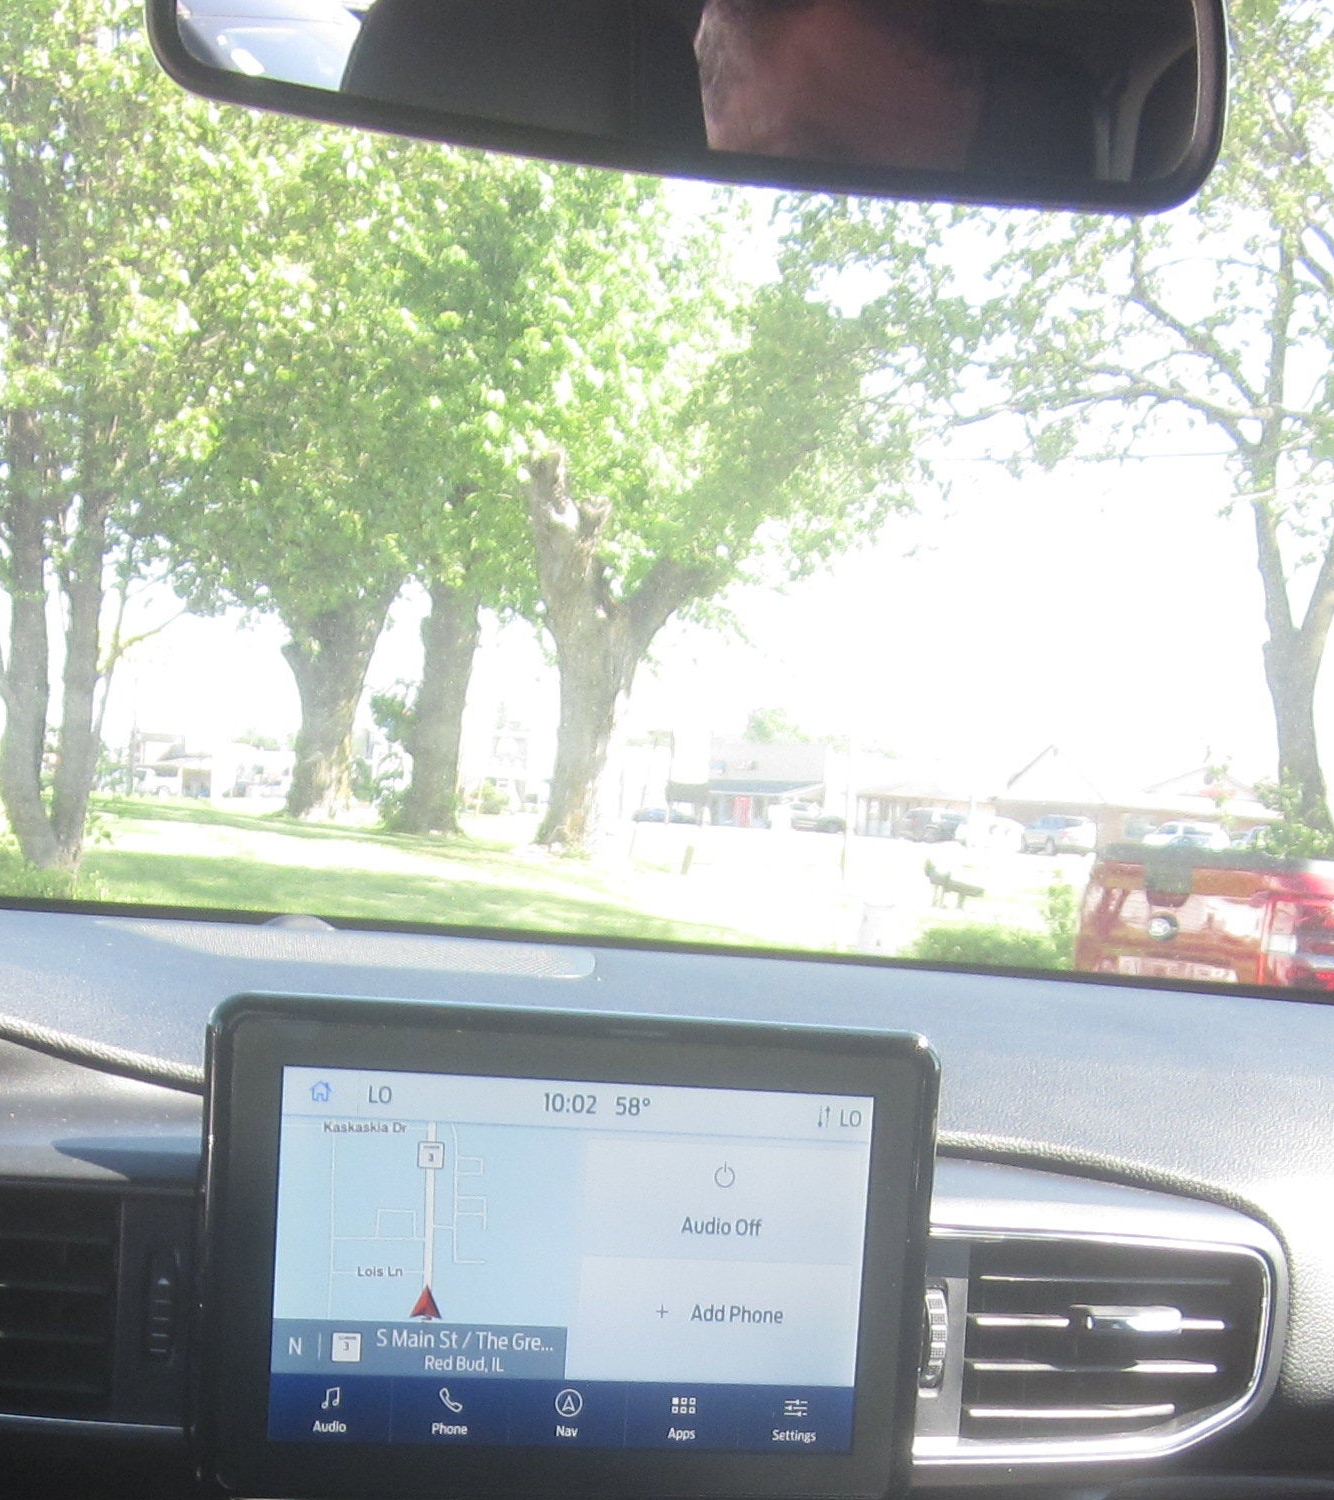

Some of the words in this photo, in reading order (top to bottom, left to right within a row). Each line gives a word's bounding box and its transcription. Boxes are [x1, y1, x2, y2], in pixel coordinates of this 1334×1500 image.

[368, 1085, 392, 1104] LO
[543, 1092, 597, 1115] 10:02
[615, 1096, 651, 1117] 58°
[323, 1121, 389, 1134] Kaskaskia
[392, 1121, 407, 1134] Dr
[840, 1109, 862, 1128] LO
[681, 1216, 731, 1236] Audio
[735, 1218, 762, 1237] Off
[357, 1265, 384, 1277] Lois
[387, 1266, 403, 1277] Ln
[690, 1303, 725, 1323] Add
[729, 1304, 784, 1325] Phone
[288, 1337, 302, 1356] N
[376, 1328, 388, 1348] S
[392, 1329, 435, 1349] Main
[439, 1330, 458, 1350] St
[461, 1331, 472, 1350] /
[476, 1331, 508, 1350] The
[512, 1332, 554, 1352] Gre...
[424, 1355, 453, 1372] Red
[456, 1356, 489, 1374] Bud,
[492, 1357, 504, 1372] IL
[312, 1420, 347, 1433] Audio
[431, 1422, 468, 1436] Phone
[555, 1425, 578, 1438] Nav
[667, 1427, 696, 1441] Apps
[771, 1428, 817, 1444] Settings
